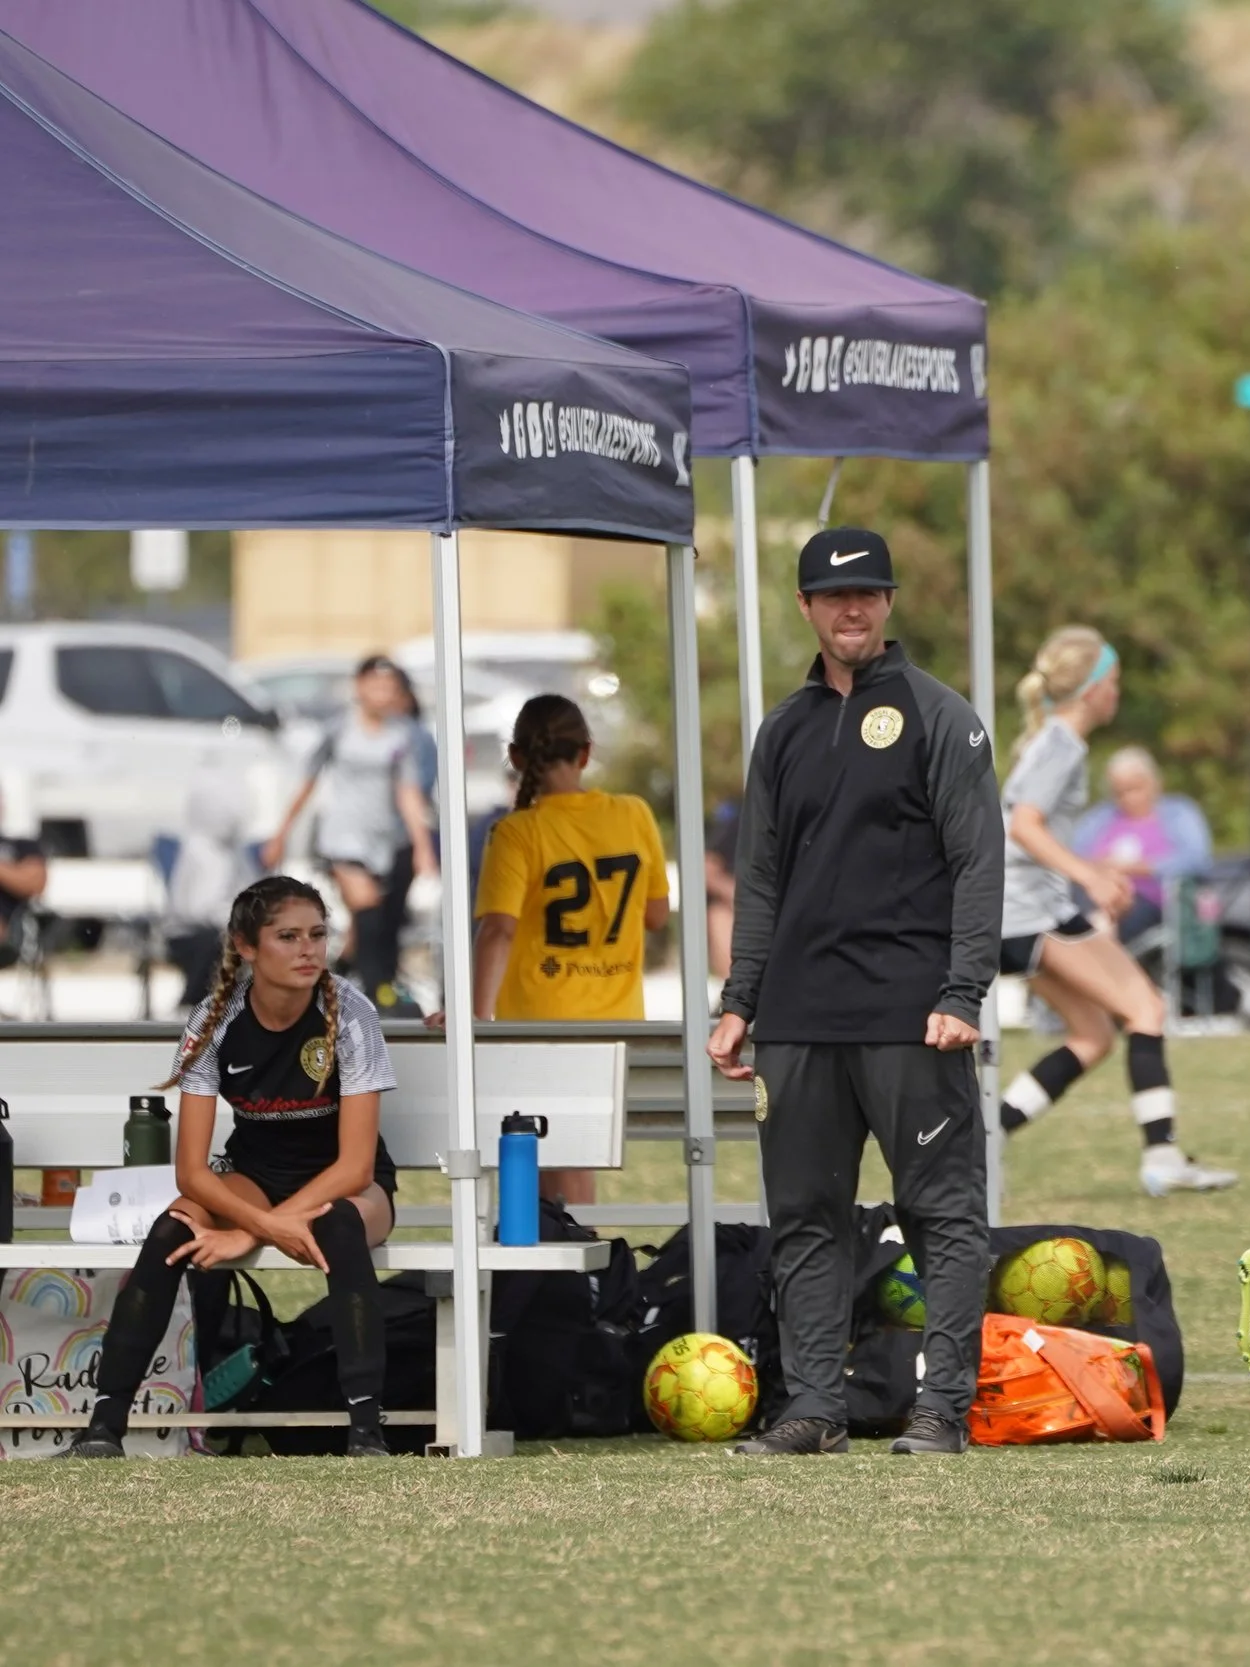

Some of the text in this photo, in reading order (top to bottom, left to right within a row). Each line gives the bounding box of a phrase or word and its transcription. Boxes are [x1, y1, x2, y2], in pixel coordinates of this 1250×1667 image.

[843, 339, 959, 393] @SILVERLAKESSPORTS
[558, 406, 661, 467] @SILVERLAKESSPORTS
[543, 853, 641, 948] 27
